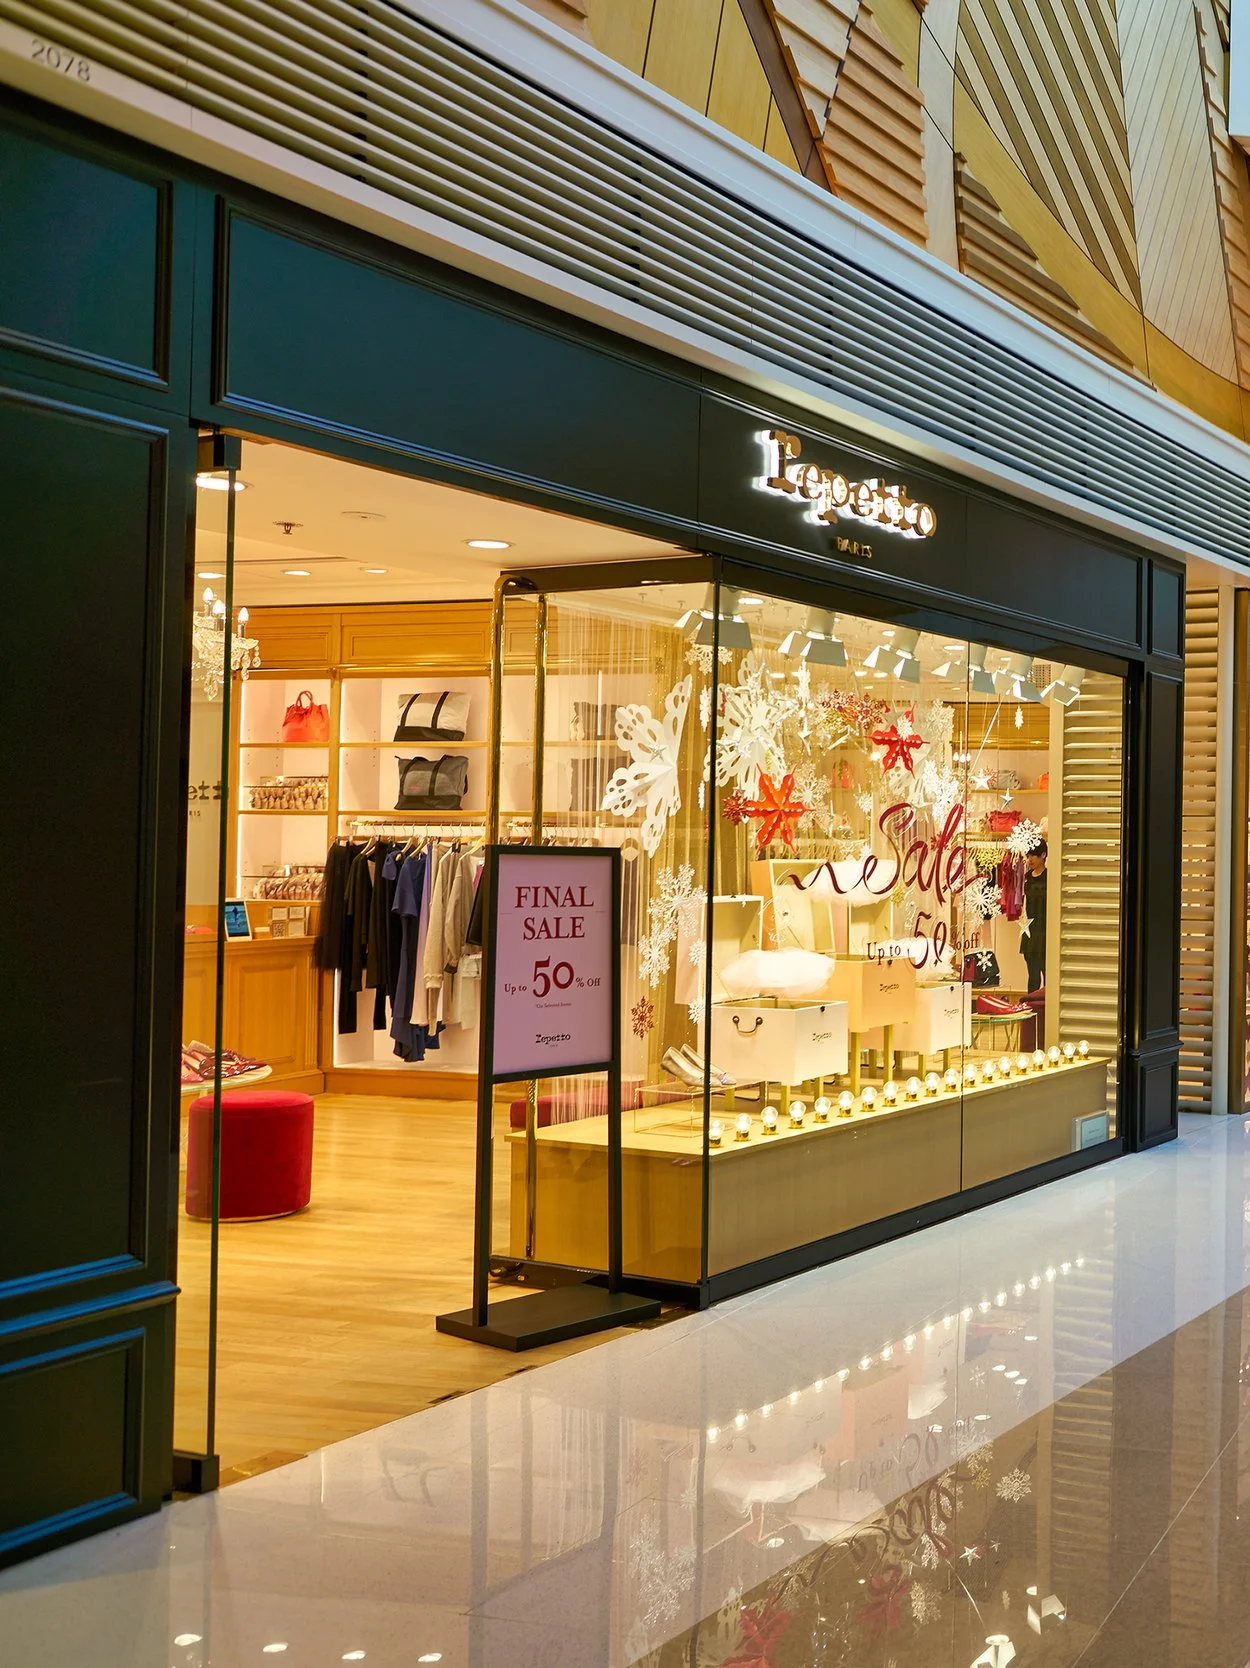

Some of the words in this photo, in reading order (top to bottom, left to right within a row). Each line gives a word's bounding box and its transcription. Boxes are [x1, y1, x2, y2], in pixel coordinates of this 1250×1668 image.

[31, 39, 90, 81] 2078
[836, 536, 873, 559] PARIS
[863, 803, 988, 906] Sale
[515, 886, 594, 909] FINAL
[523, 916, 585, 940] SALE
[867, 942, 885, 965] Up
[889, 945, 901, 957] to
[907, 911, 947, 969] 50
[504, 983, 516, 995] Up
[532, 955, 574, 998] 50
[587, 977, 601, 988] Off
